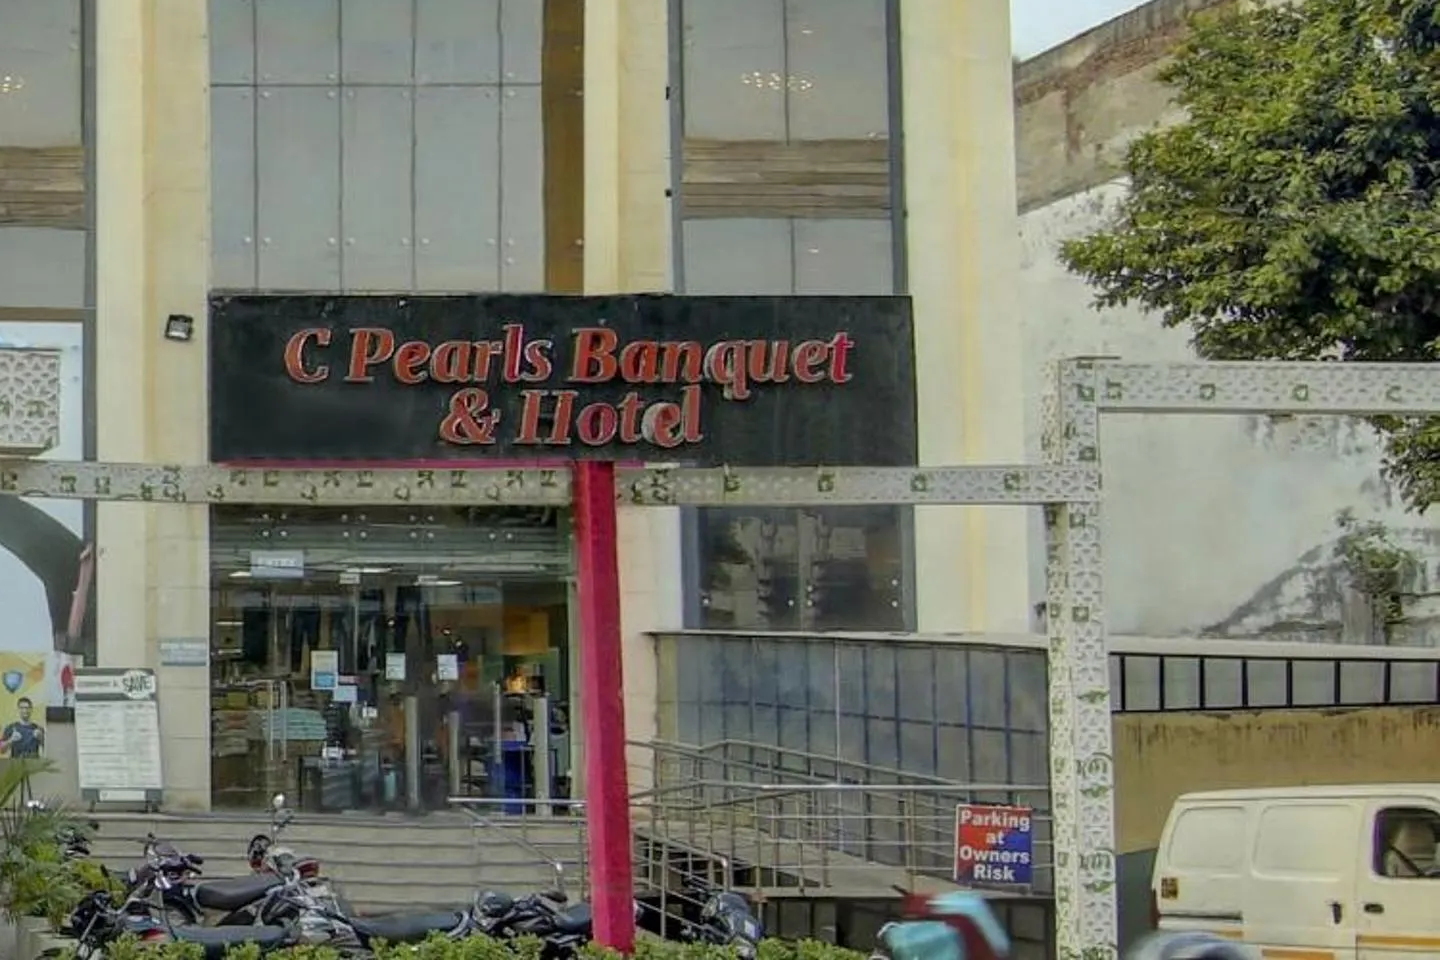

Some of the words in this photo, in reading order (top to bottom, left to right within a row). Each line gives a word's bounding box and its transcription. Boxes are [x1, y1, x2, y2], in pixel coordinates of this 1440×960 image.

[284, 327, 331, 383] C
[343, 324, 552, 383] Pearls
[567, 327, 854, 401] Banquet
[437, 386, 501, 444] &
[513, 386, 704, 448] Hotel
[960, 809, 1030, 832] Parking
[985, 830, 1005, 844] at
[960, 845, 1030, 864] Owners
[974, 863, 1016, 881] Risk
